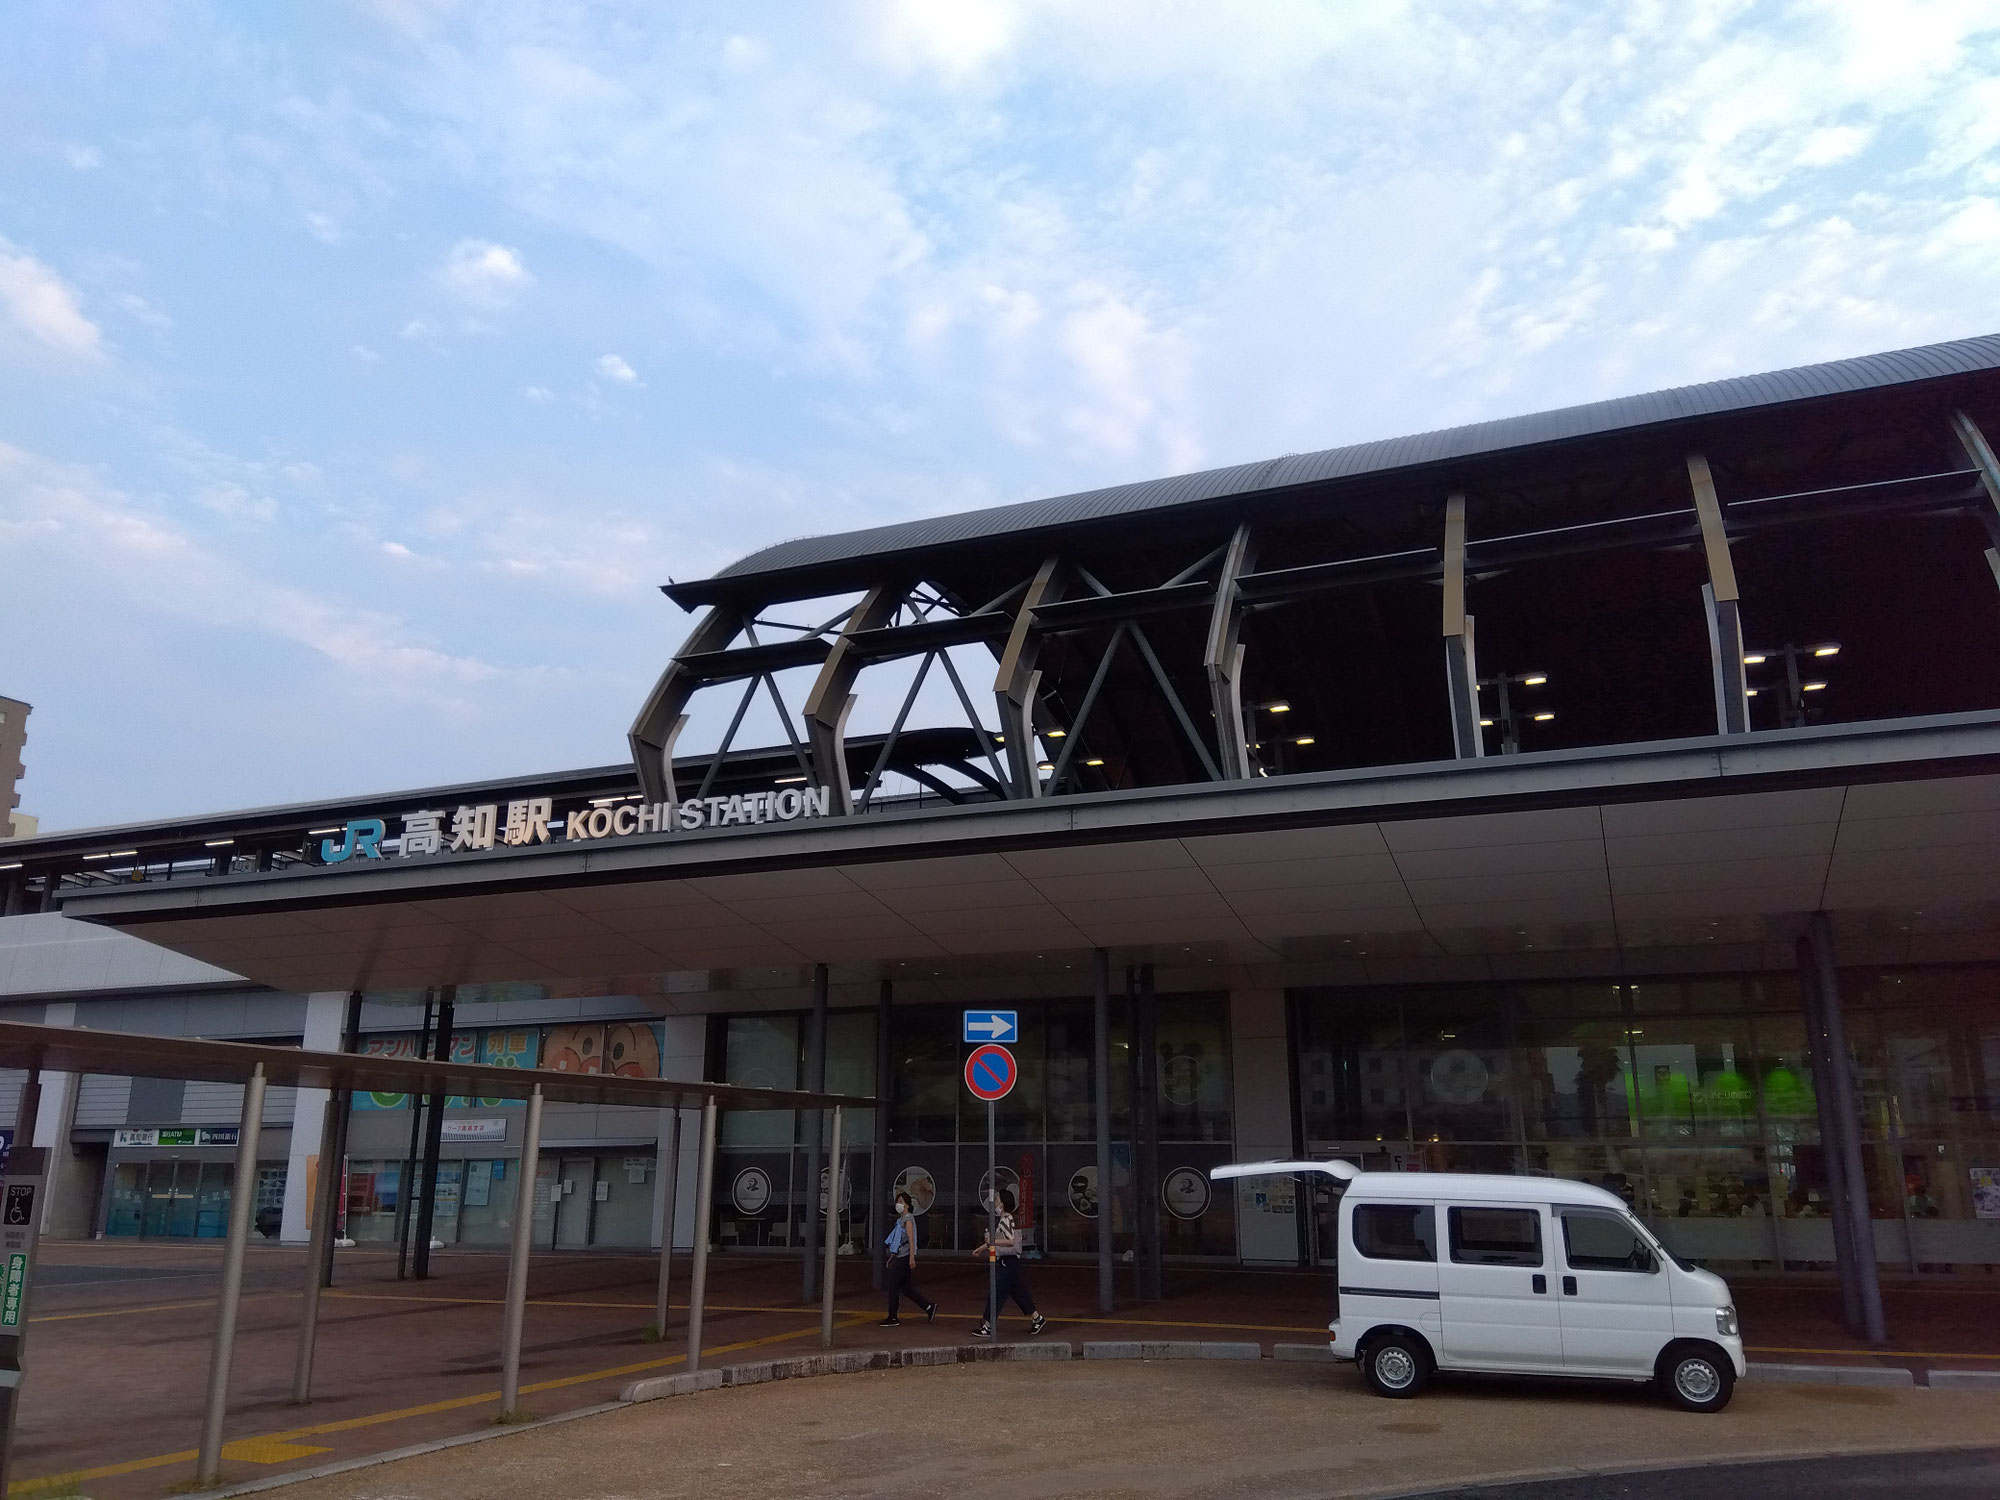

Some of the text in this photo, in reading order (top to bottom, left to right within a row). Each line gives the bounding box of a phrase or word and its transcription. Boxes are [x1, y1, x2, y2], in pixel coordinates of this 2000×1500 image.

[321, 818, 386, 862] JR
[399, 797, 552, 858] 高知駅
[681, 785, 830, 830] STATION
[11, 1187, 32, 1196] STOP
[4, 1256, 24, 1324] 身障者専用
